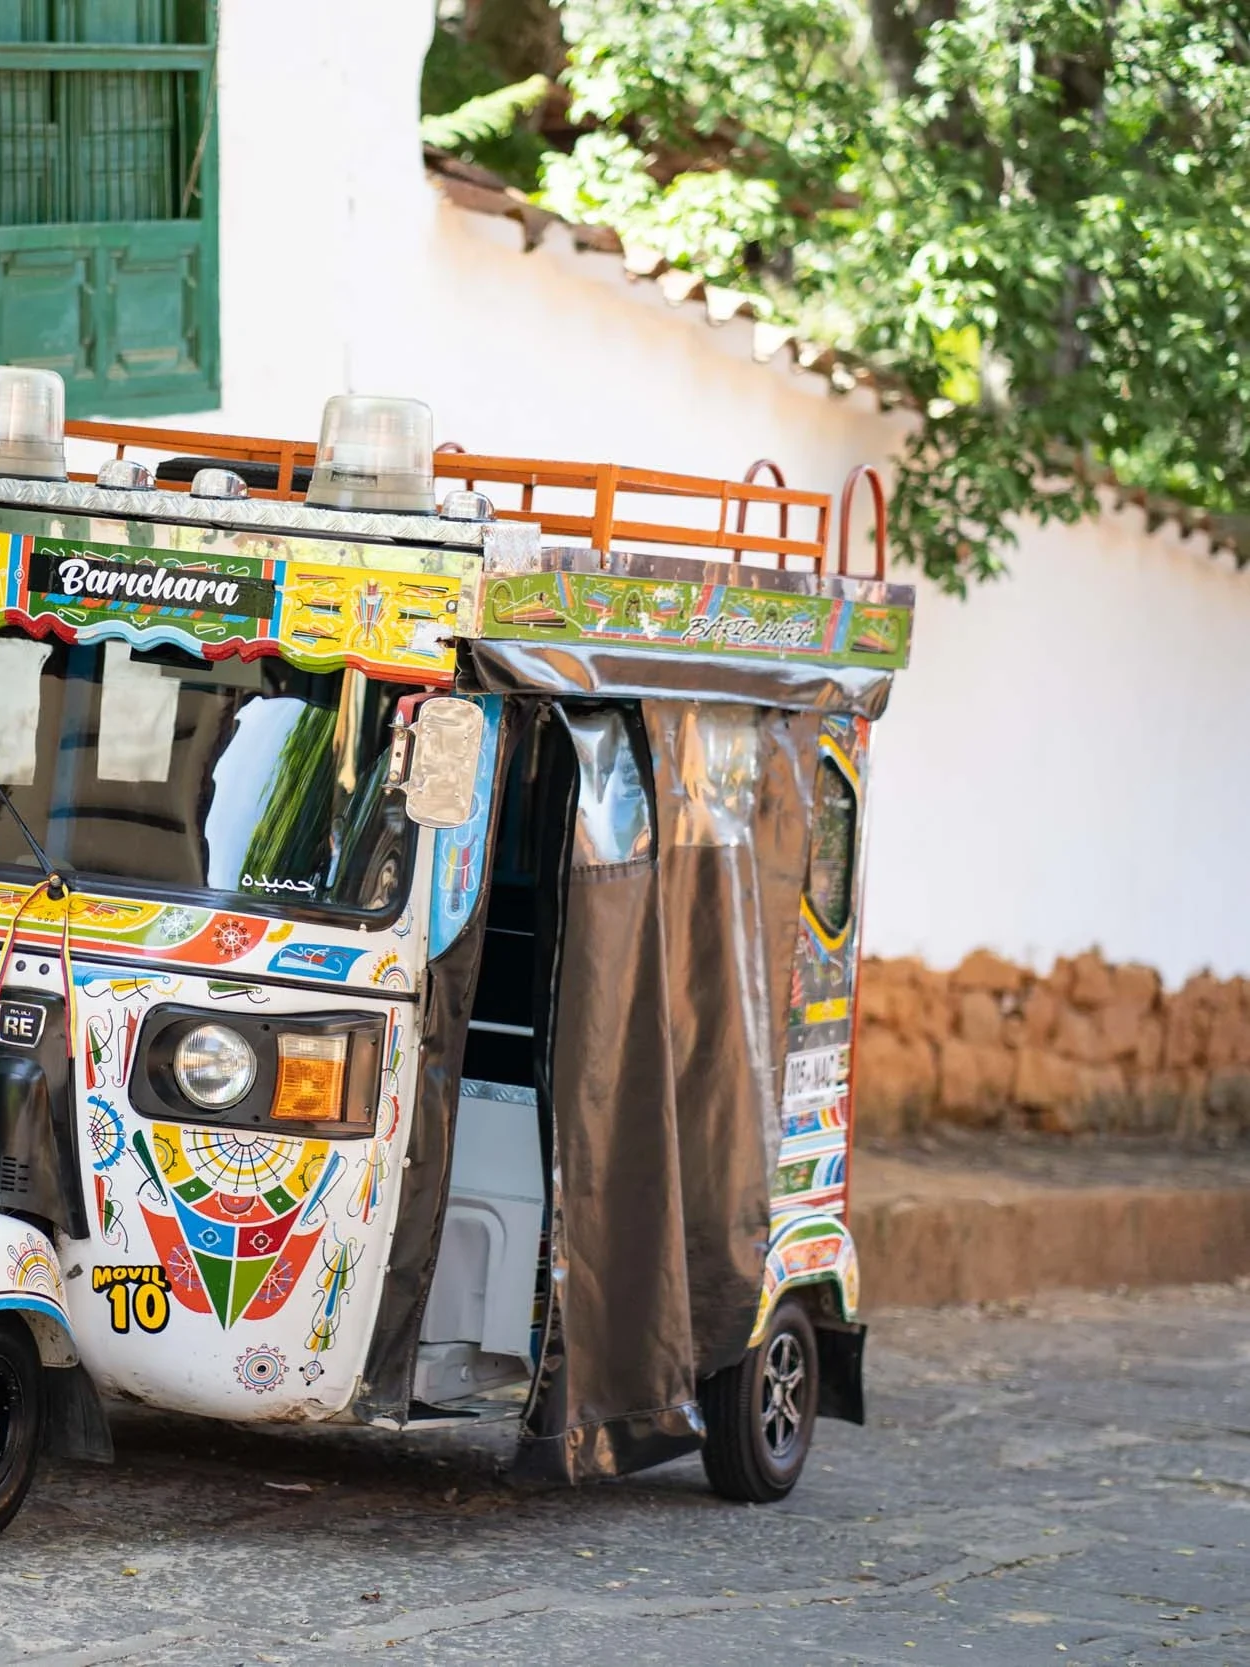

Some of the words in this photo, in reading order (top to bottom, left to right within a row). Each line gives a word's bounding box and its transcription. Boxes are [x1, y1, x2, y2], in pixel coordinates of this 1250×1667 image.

[58, 558, 240, 606] Barichara
[681, 613, 817, 645] BARICHARA
[3, 1015, 35, 1038] RE
[92, 1265, 169, 1292] MOVIL
[107, 1282, 170, 1334] 10
